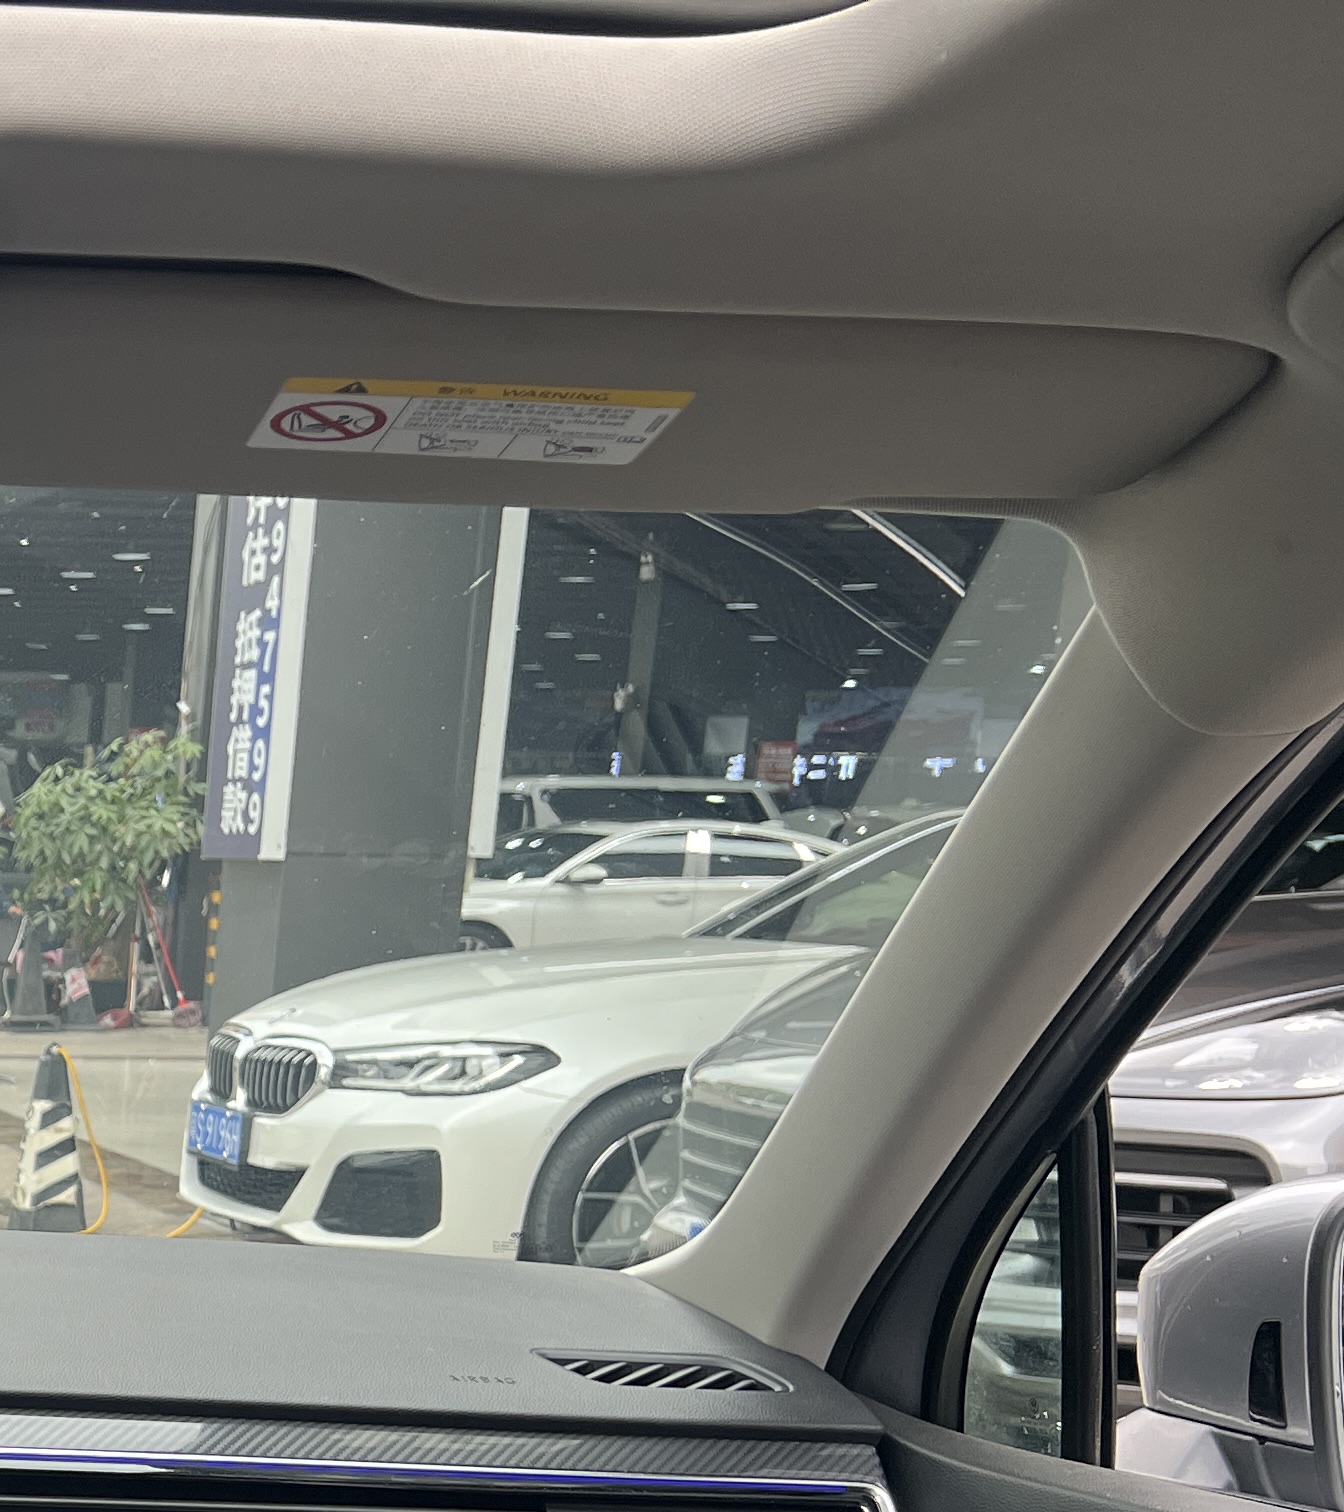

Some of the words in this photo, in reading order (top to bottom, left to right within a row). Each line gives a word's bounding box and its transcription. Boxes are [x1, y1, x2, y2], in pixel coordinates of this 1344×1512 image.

[220, 607, 262, 835] 抵押借款
[449, 1374, 517, 1385] AIRBAG
